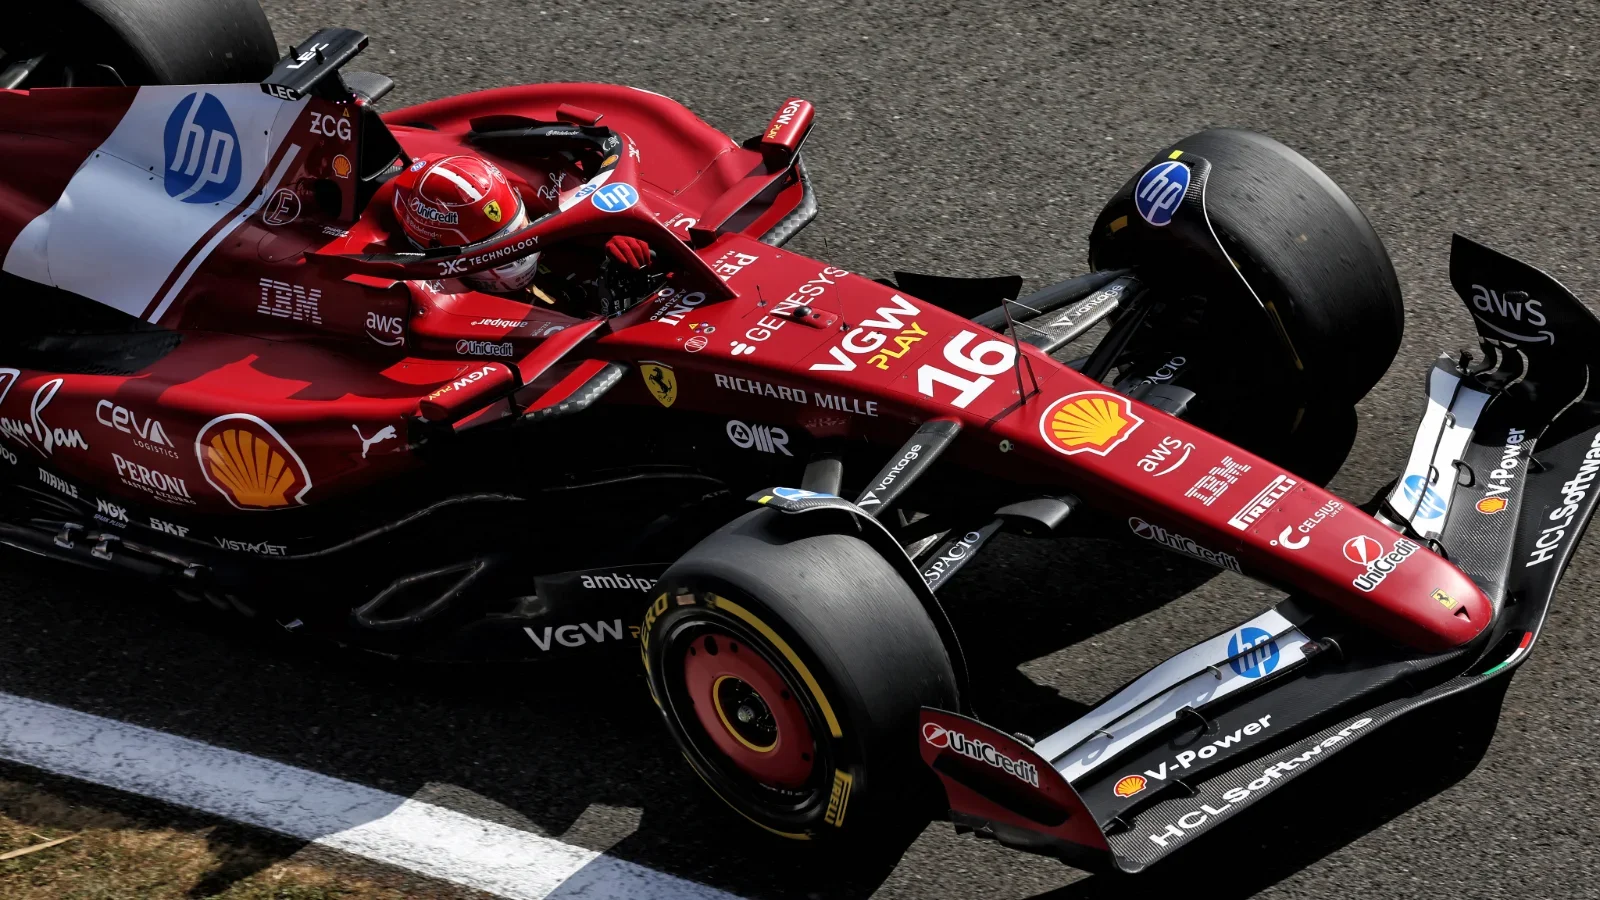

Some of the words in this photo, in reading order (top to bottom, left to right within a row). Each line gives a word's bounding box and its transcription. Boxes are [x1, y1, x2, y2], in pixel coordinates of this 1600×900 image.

[286, 42, 330, 70] LEC
[268, 85, 297, 101] LEC
[776, 99, 805, 125] VGW
[164, 92, 242, 204] hp
[309, 112, 352, 141] ZCG
[417, 203, 458, 224] UniCredit
[592, 182, 639, 213] hp
[1135, 161, 1191, 226] hp
[469, 235, 539, 265] TECHNOLOGY
[257, 278, 322, 324] IBM
[746, 266, 849, 342] GENESYS
[1072, 284, 1124, 317] vantage
[1472, 284, 1547, 326] aws
[366, 312, 403, 335] aws
[809, 294, 922, 372] VGW
[467, 341, 513, 357] UniCredit
[867, 322, 928, 370] PLAY
[453, 366, 497, 391] VGW
[917, 329, 1018, 409] 16
[428, 387, 452, 401] PLAY
[714, 374, 807, 404] RICHARD
[814, 392, 879, 417] MILLE
[133, 439, 179, 459] LOGISTICS
[875, 444, 922, 491] vantage
[1137, 436, 1183, 472] aws
[1486, 428, 1526, 496] V-Power
[38, 467, 79, 499] MAHLE
[112, 452, 192, 499] PERONI
[1184, 456, 1252, 507] IBM
[95, 497, 130, 523] NGK
[1227, 474, 1298, 531] PIRELLI
[1298, 499, 1341, 534] CELSIUS
[1525, 432, 1600, 567] HCLSoftwar
[150, 517, 190, 538] SKF
[1150, 524, 1241, 573] UniCredit
[1352, 538, 1422, 592] UniCredit
[523, 619, 623, 651] VGW
[1227, 627, 1280, 678] hp
[947, 731, 1040, 789] UniCredit
[1143, 712, 1273, 781] V-Power
[824, 767, 853, 828] PIRELLI
[1149, 716, 1374, 849] HCLSoftware
